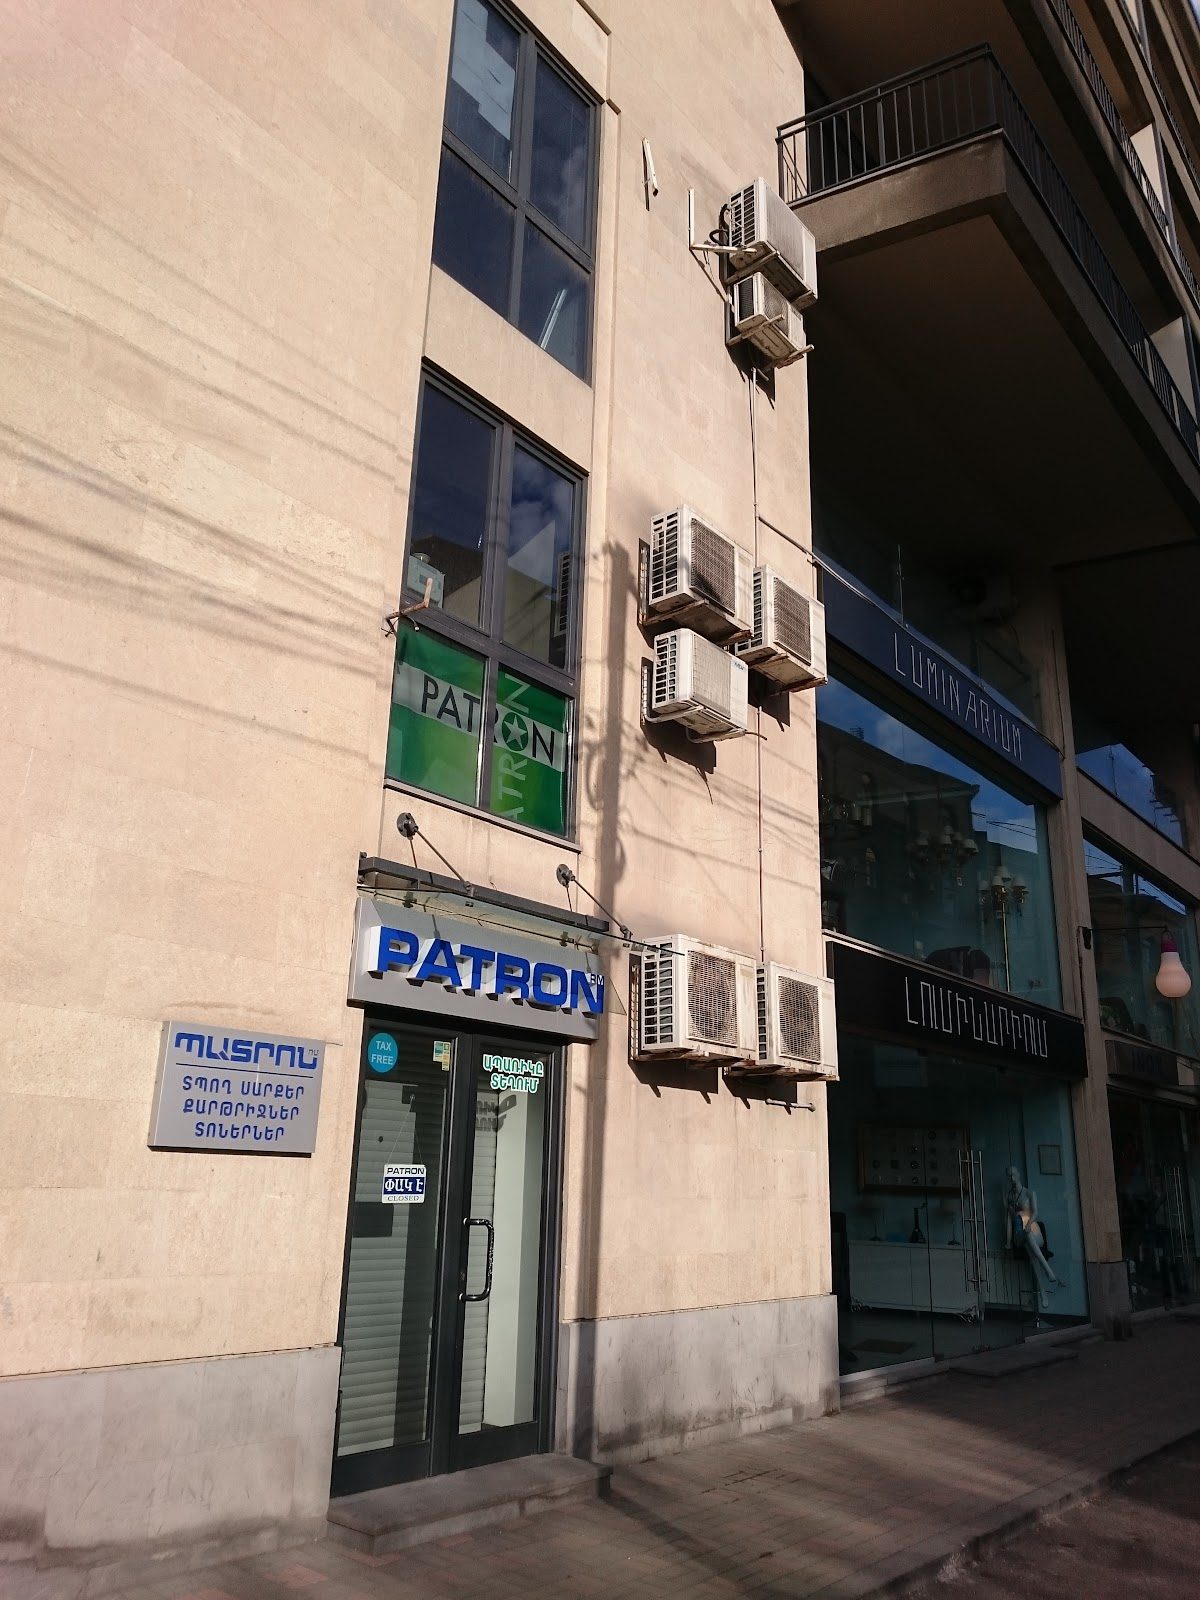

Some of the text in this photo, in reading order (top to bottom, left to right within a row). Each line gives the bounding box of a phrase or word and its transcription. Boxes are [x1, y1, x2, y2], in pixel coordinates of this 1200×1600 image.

[894, 633, 1022, 761] LUMINARIUM
[374, 925, 605, 1014] PATRON
[174, 1032, 318, 1070] ՊԱՏՐՈՆ
[375, 1041, 392, 1052] TAX
[370, 1053, 394, 1065] FREE
[482, 1054, 545, 1077] ԱՊԱՌԻԿԸ
[182, 1075, 305, 1100] ՏՊՈՂ ՍԱՐՔԵՐ
[490, 1073, 539, 1093] ՏԵՂՈՒՄ
[183, 1098, 299, 1120] ՔԱՐԹՐԻՋՆԵՐ
[195, 1121, 284, 1141] ՏՈՆԵՐՆԵՐ
[387, 1167, 425, 1175] PATRON
[385, 1178, 424, 1192] ՓԱԿ Է
